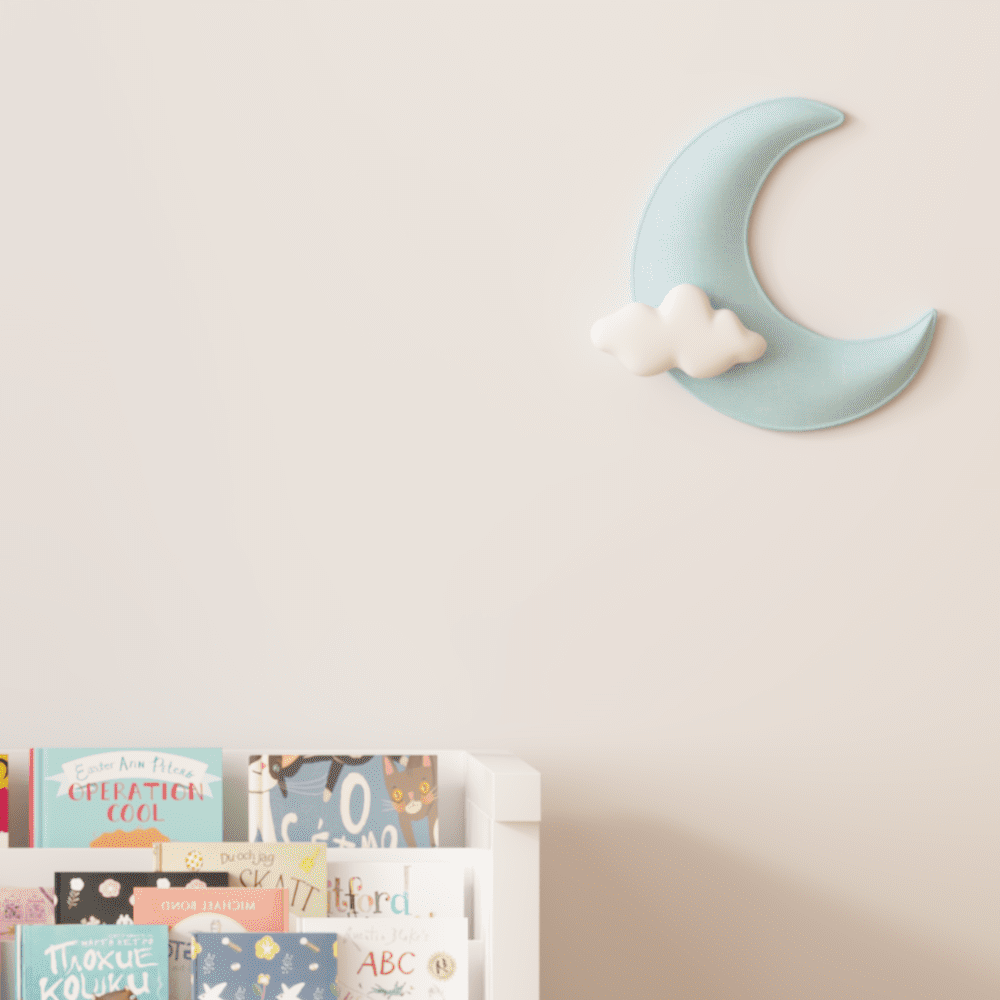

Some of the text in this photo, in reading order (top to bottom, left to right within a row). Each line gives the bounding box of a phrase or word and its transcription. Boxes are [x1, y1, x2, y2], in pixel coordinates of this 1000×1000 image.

[68, 782, 204, 801] OPERATION
[107, 803, 165, 823] COOL
[357, 951, 416, 977] ABC
